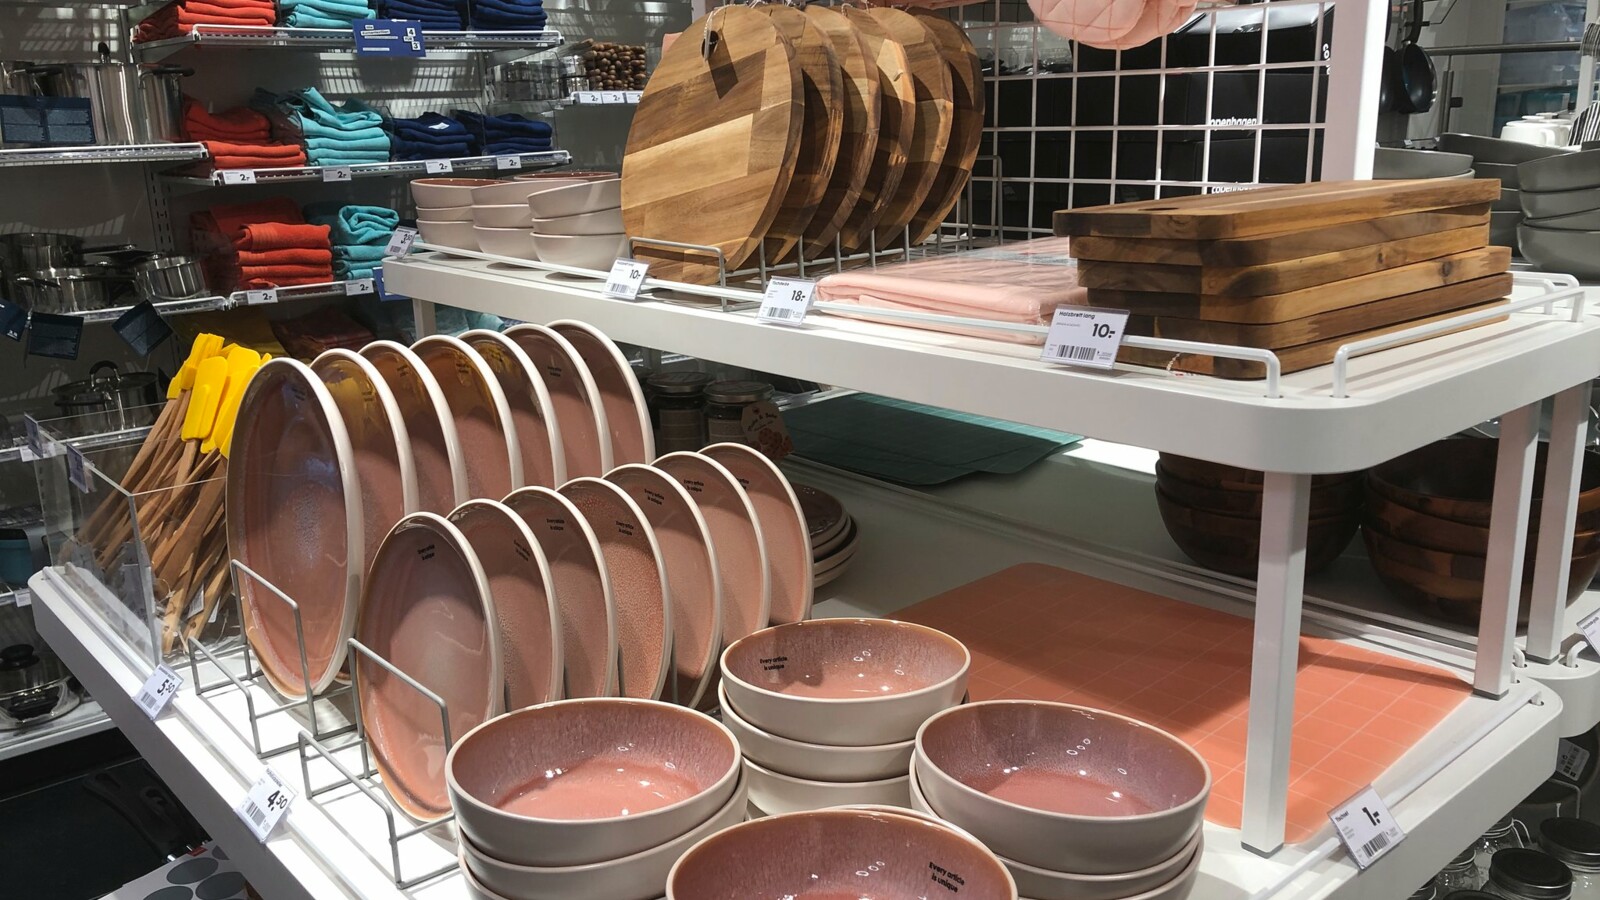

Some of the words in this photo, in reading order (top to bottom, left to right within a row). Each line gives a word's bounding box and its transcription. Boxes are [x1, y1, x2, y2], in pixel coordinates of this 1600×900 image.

[791, 290, 806, 301] 18.-
[1092, 323, 1116, 339] 10.-
[929, 861, 947, 876] Every
[947, 871, 965, 886] article
[931, 872, 938, 882] is
[937, 877, 958, 893] unique
